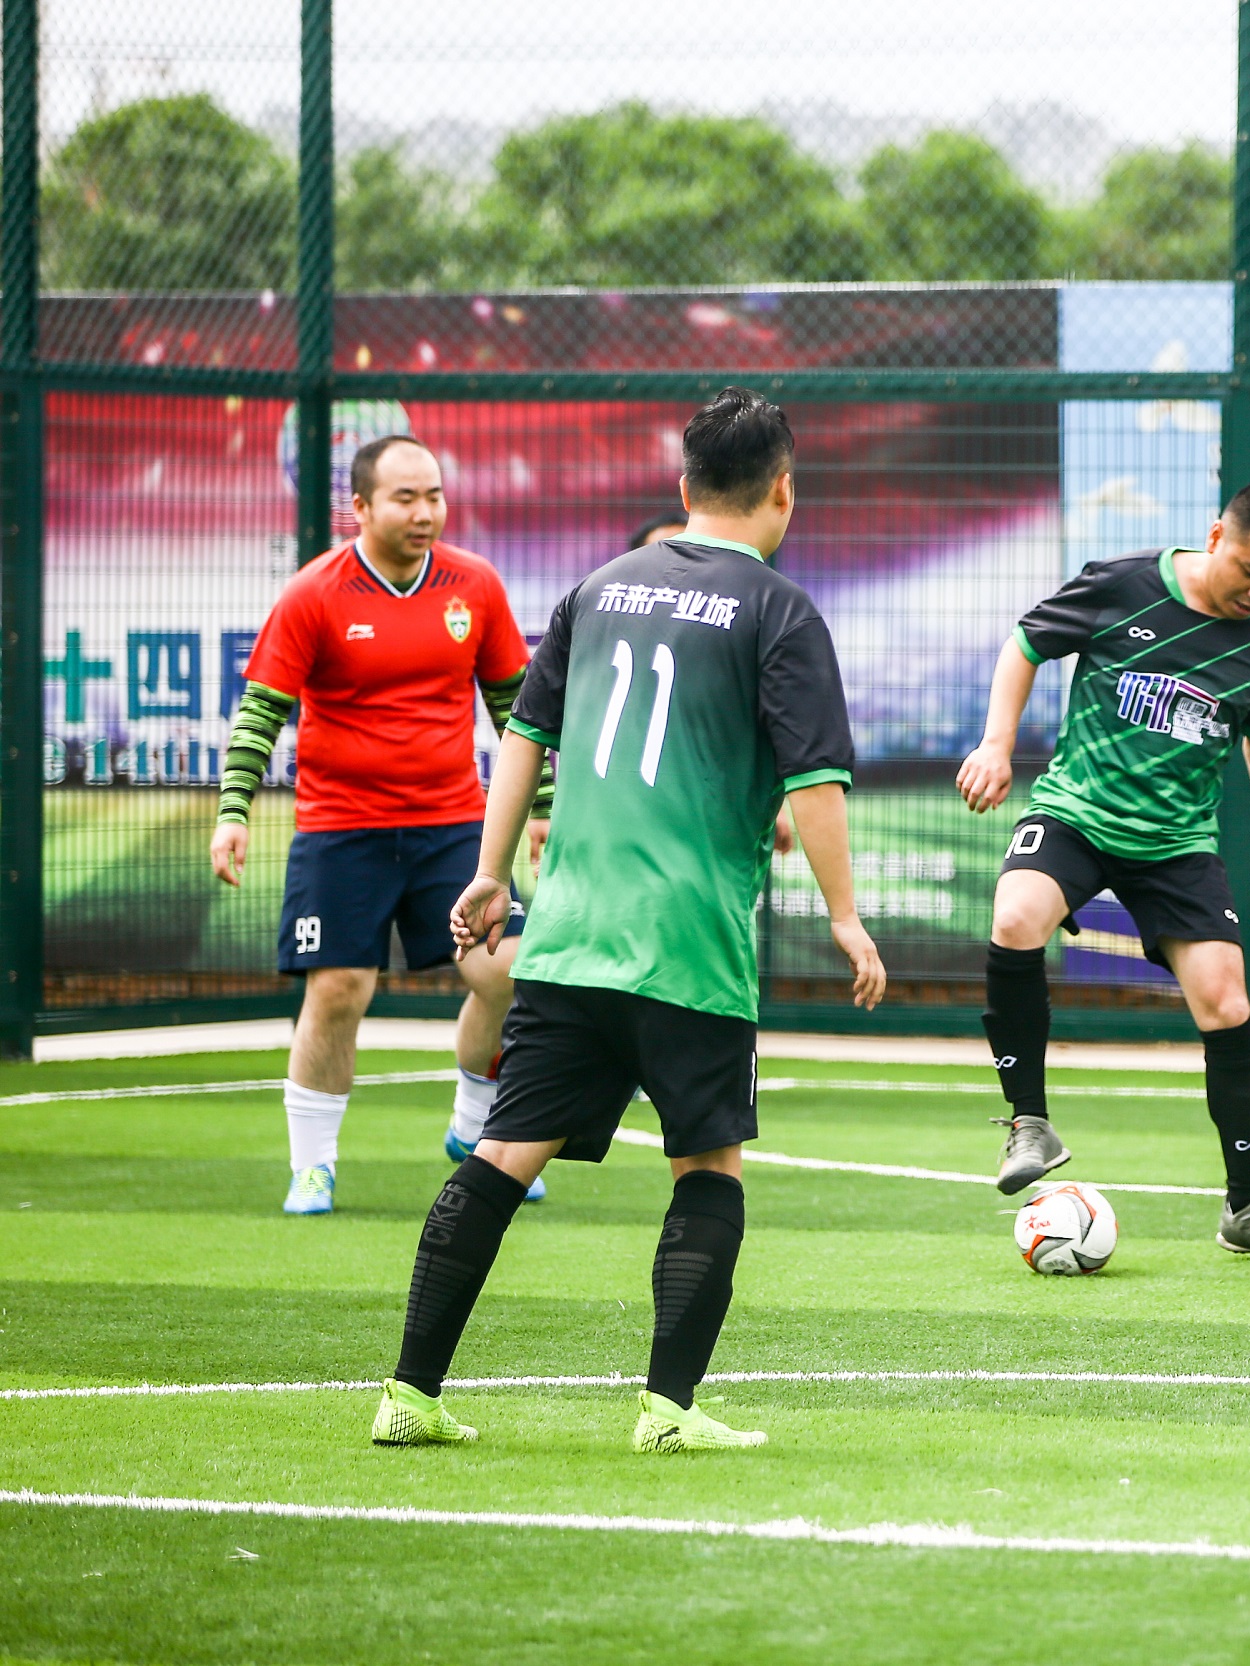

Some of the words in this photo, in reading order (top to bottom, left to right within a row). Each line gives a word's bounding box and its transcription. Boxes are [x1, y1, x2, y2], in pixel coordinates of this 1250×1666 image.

[596, 581, 741, 630] 未来产业城
[593, 638, 677, 789] 11
[1003, 822, 1047, 861] 10
[294, 915, 322, 955] 99
